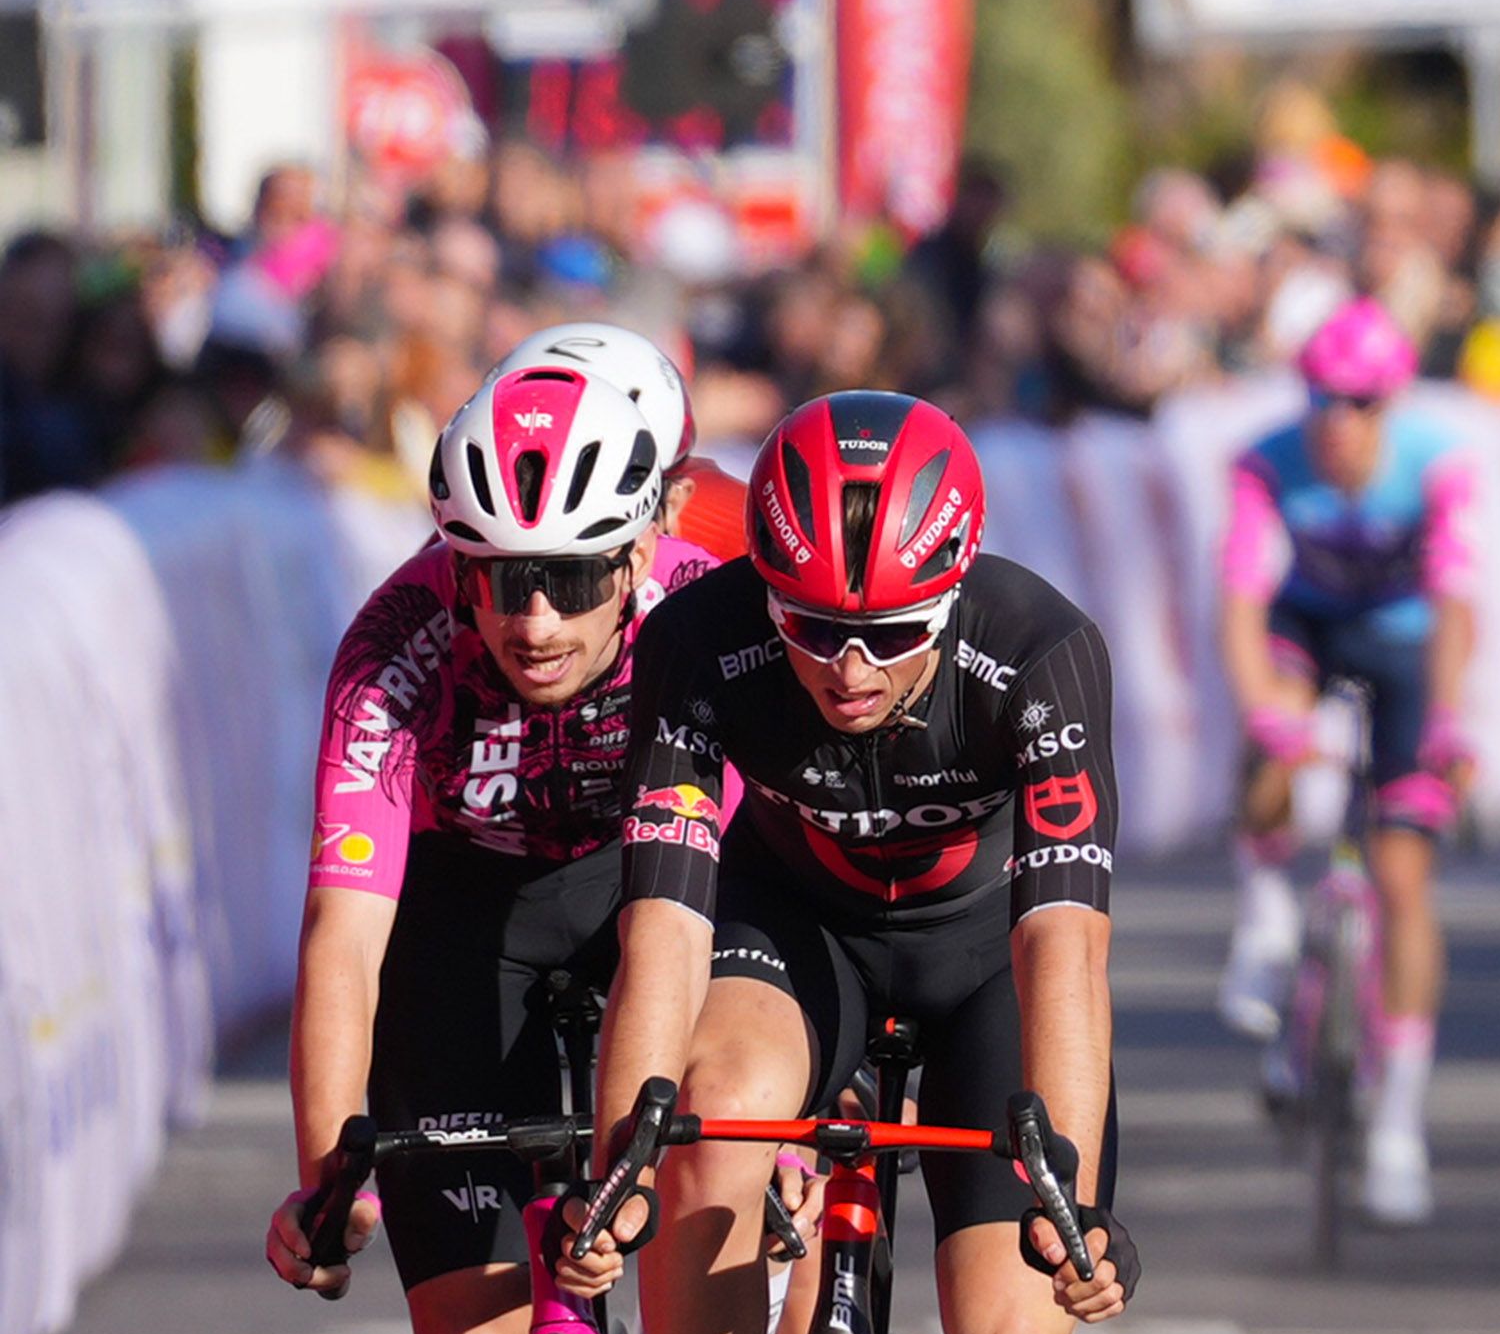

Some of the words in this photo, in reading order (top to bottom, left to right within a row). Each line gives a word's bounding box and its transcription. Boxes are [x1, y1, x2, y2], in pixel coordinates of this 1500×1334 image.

[838, 440, 889, 451] TUDOR
[765, 493, 799, 553] TUDOR
[914, 502, 957, 557] TUDOR
[718, 637, 784, 681] BMC
[333, 699, 402, 795] VAN
[655, 715, 723, 764] MSC
[1016, 723, 1086, 769] MSC
[893, 768, 979, 788] sportful
[622, 815, 685, 849] Red
[1012, 843, 1114, 879] TUDOR
[829, 1251, 855, 1331] BMC
